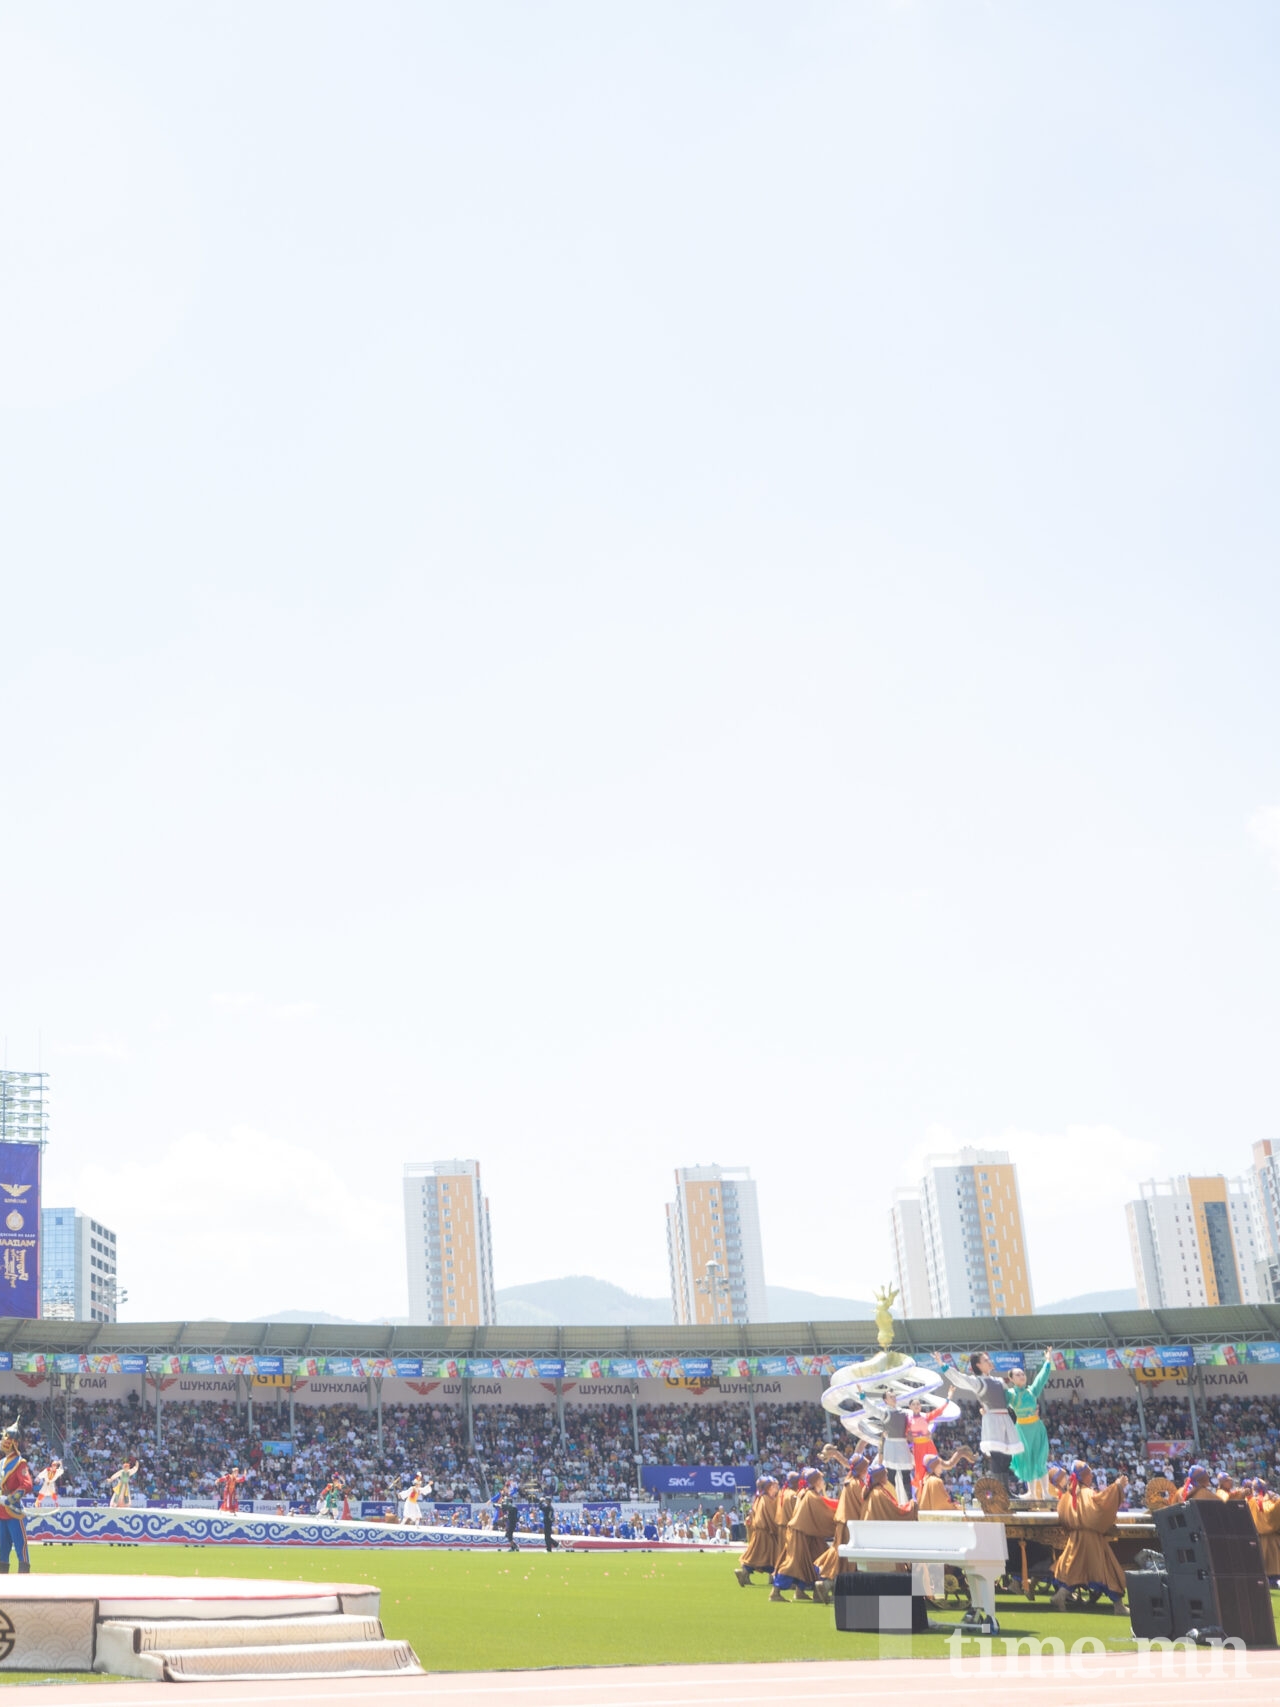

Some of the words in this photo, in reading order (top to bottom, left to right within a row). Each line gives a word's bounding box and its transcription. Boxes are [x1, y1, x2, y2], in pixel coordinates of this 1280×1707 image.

[179, 1380, 237, 1392] ШУНХЛАЙ
[310, 1380, 368, 1393] ШУНХЛАЙ
[443, 1382, 502, 1394] ШУХЛАЙ
[710, 1471, 736, 1487] 5G
